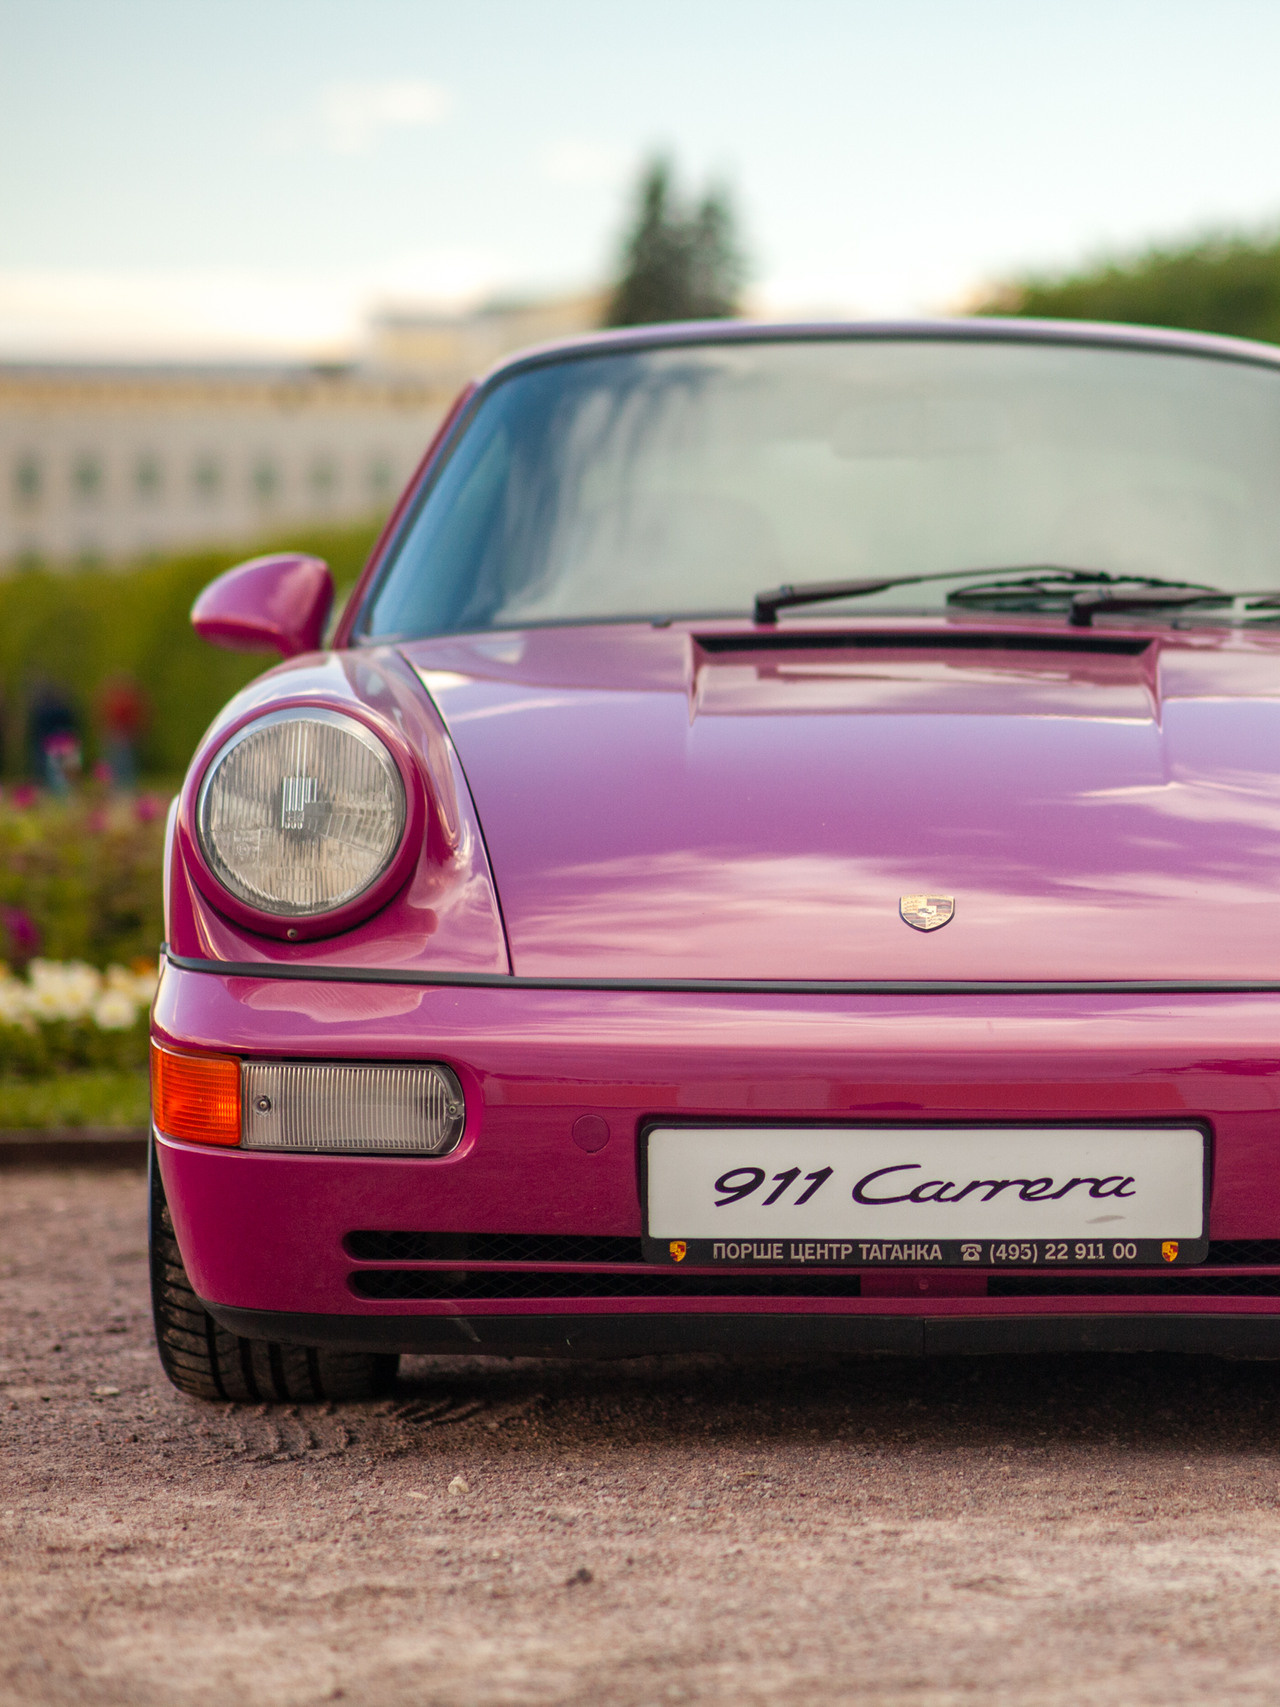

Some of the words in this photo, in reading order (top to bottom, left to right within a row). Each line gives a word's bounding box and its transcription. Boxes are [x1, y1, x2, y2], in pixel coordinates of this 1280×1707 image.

[714, 1166, 834, 1207] 911
[852, 1164, 1137, 1205] Carrera
[713, 1243, 784, 1260] ПОРШЕ
[790, 1243, 853, 1263] ЦЕНТР
[858, 1243, 943, 1261] ТАГАНКА
[989, 1243, 1038, 1263] (495)
[1044, 1243, 1069, 1260] 22
[1074, 1243, 1105, 1260] 911
[1112, 1243, 1138, 1260] 00
